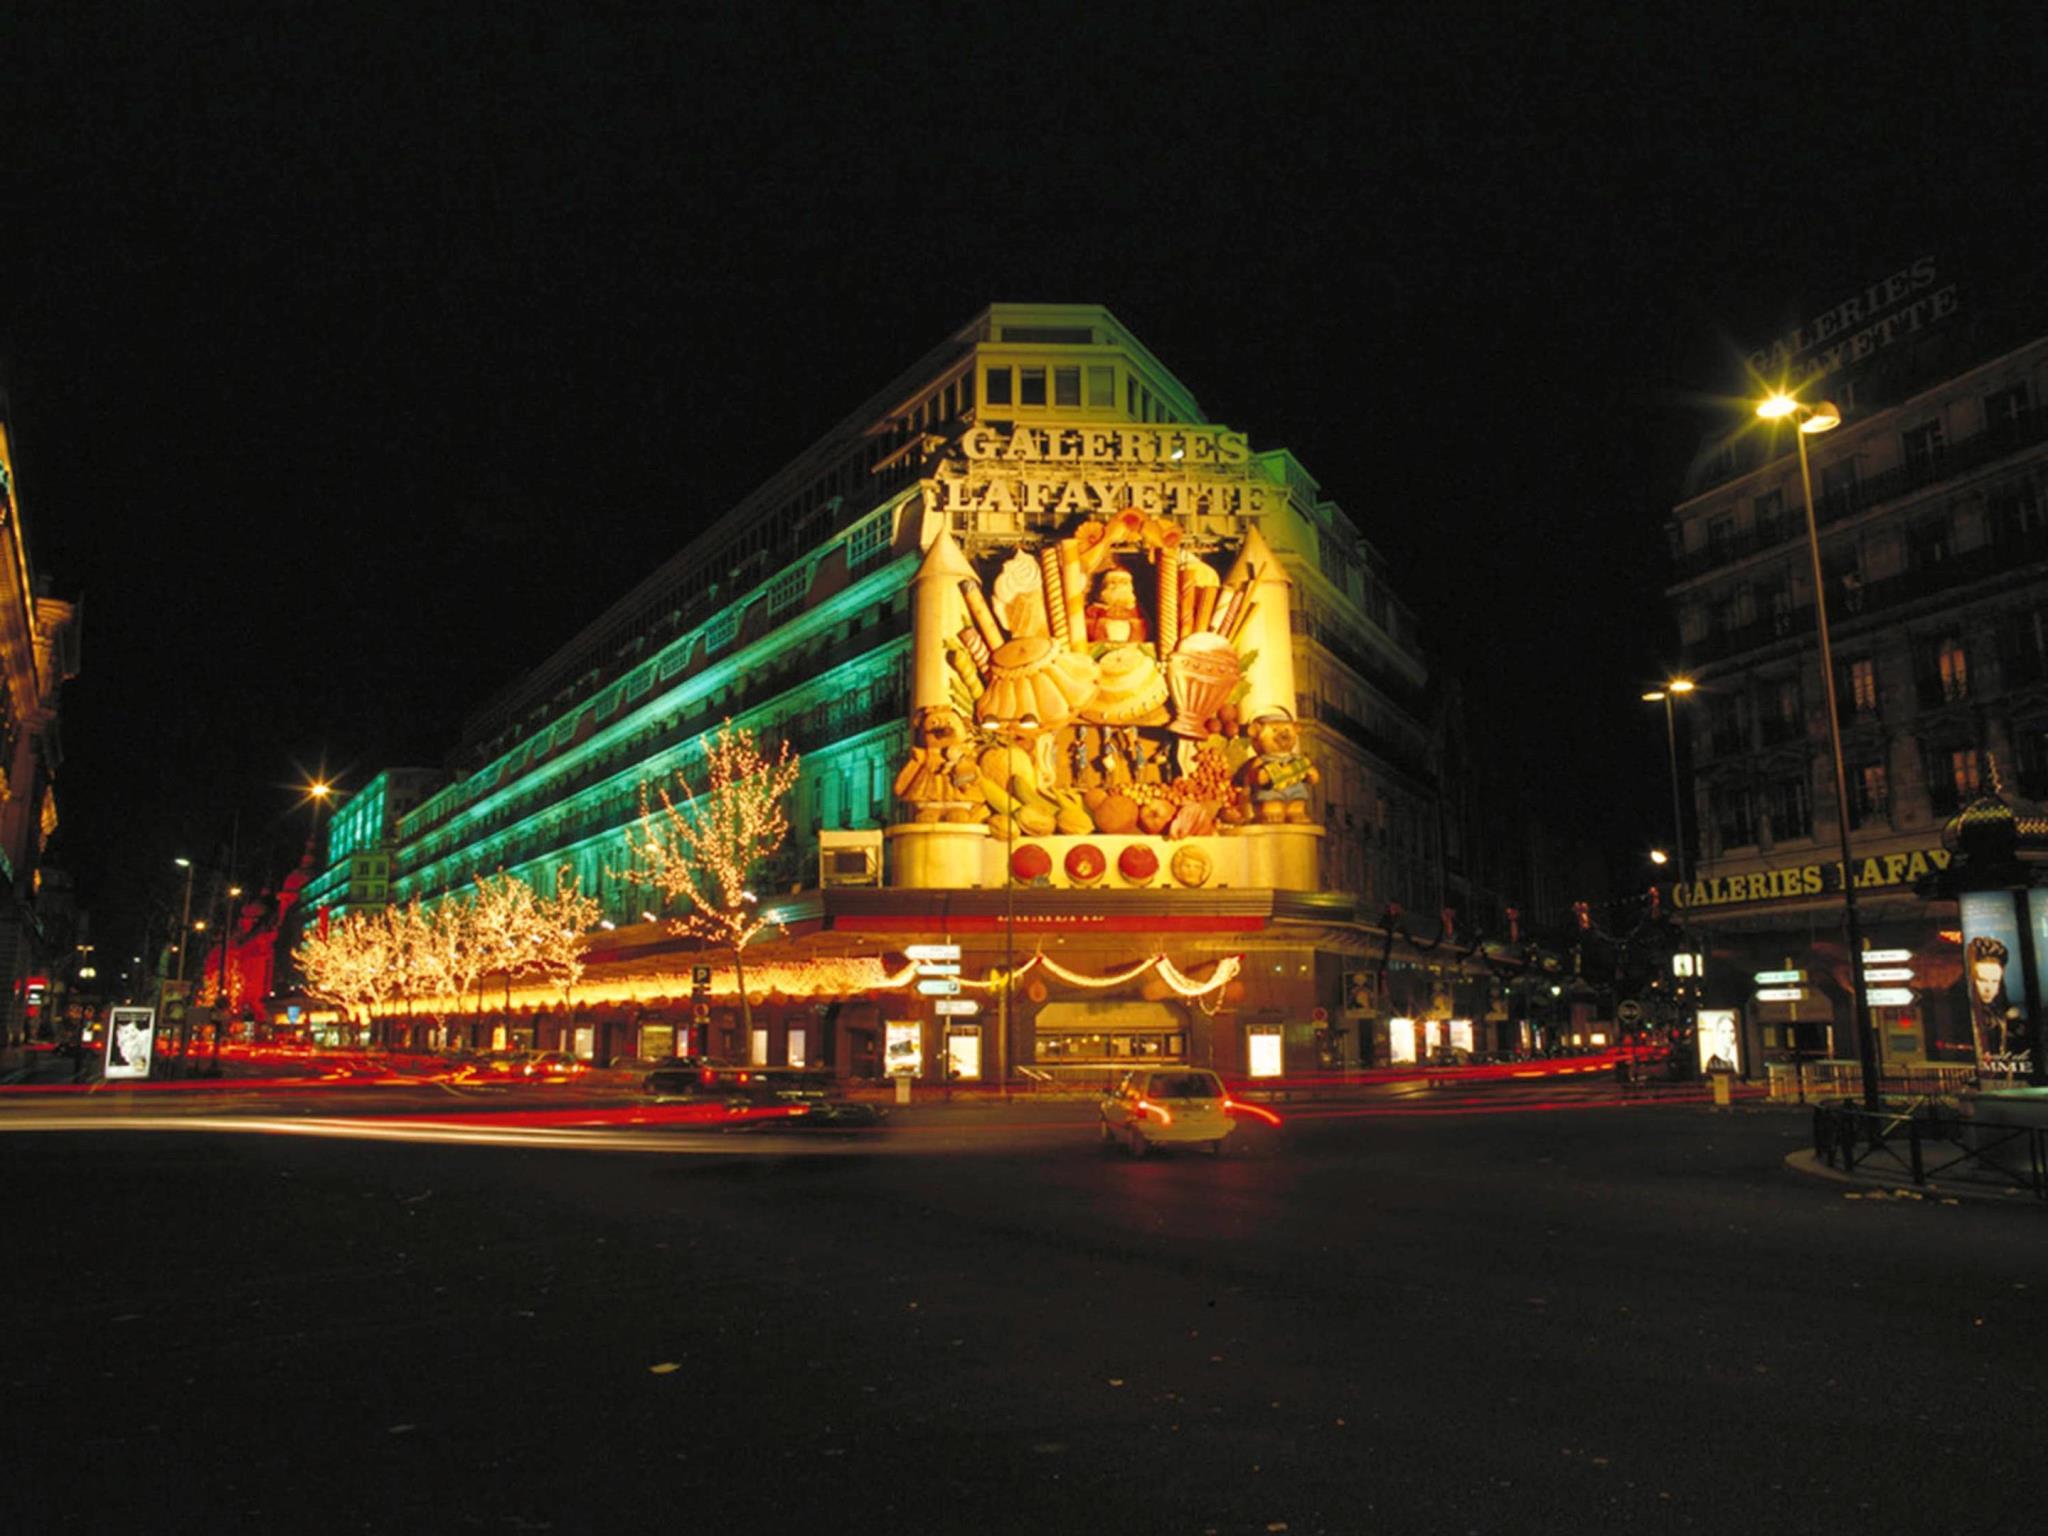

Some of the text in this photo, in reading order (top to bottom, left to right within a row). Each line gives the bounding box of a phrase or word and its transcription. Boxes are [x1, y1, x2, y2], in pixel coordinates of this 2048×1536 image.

[962, 427, 1249, 465] GALERIES
[944, 478, 1271, 515] LAFAYETTE
[1672, 865, 1823, 909] GALERIES
